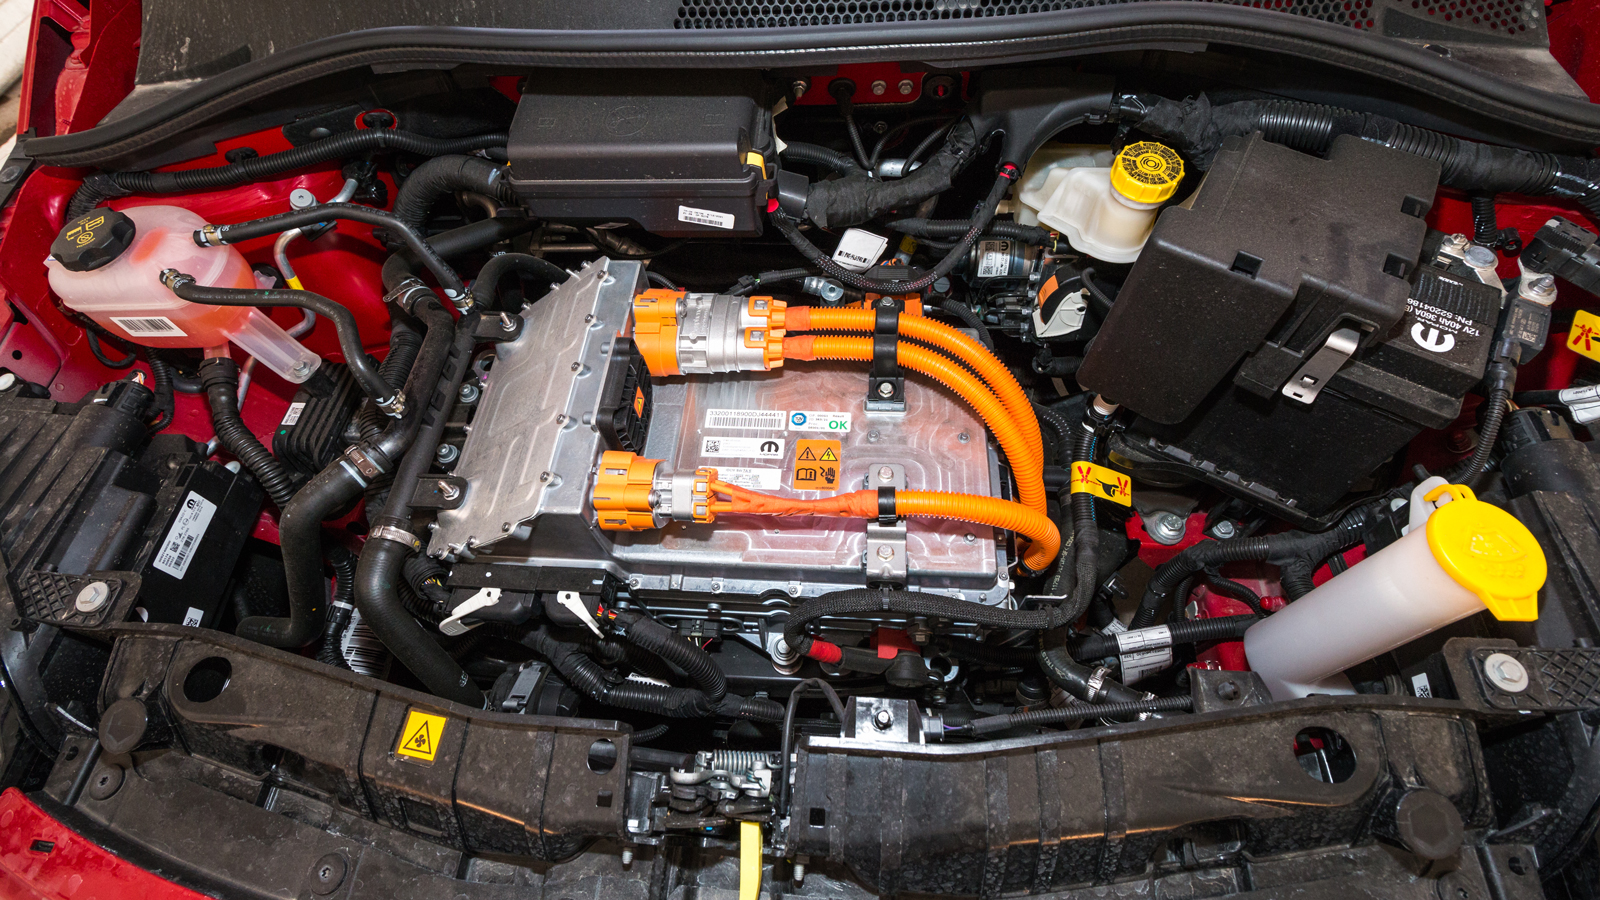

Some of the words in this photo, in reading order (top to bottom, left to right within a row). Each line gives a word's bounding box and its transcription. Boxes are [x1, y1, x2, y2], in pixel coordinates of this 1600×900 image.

[1415, 308, 1438, 322] 360A
[1455, 315, 1473, 326] PN:
[1439, 317, 1462, 330] 40Ah
[1463, 326, 1480, 336] 12V
[828, 420, 848, 430] OK
